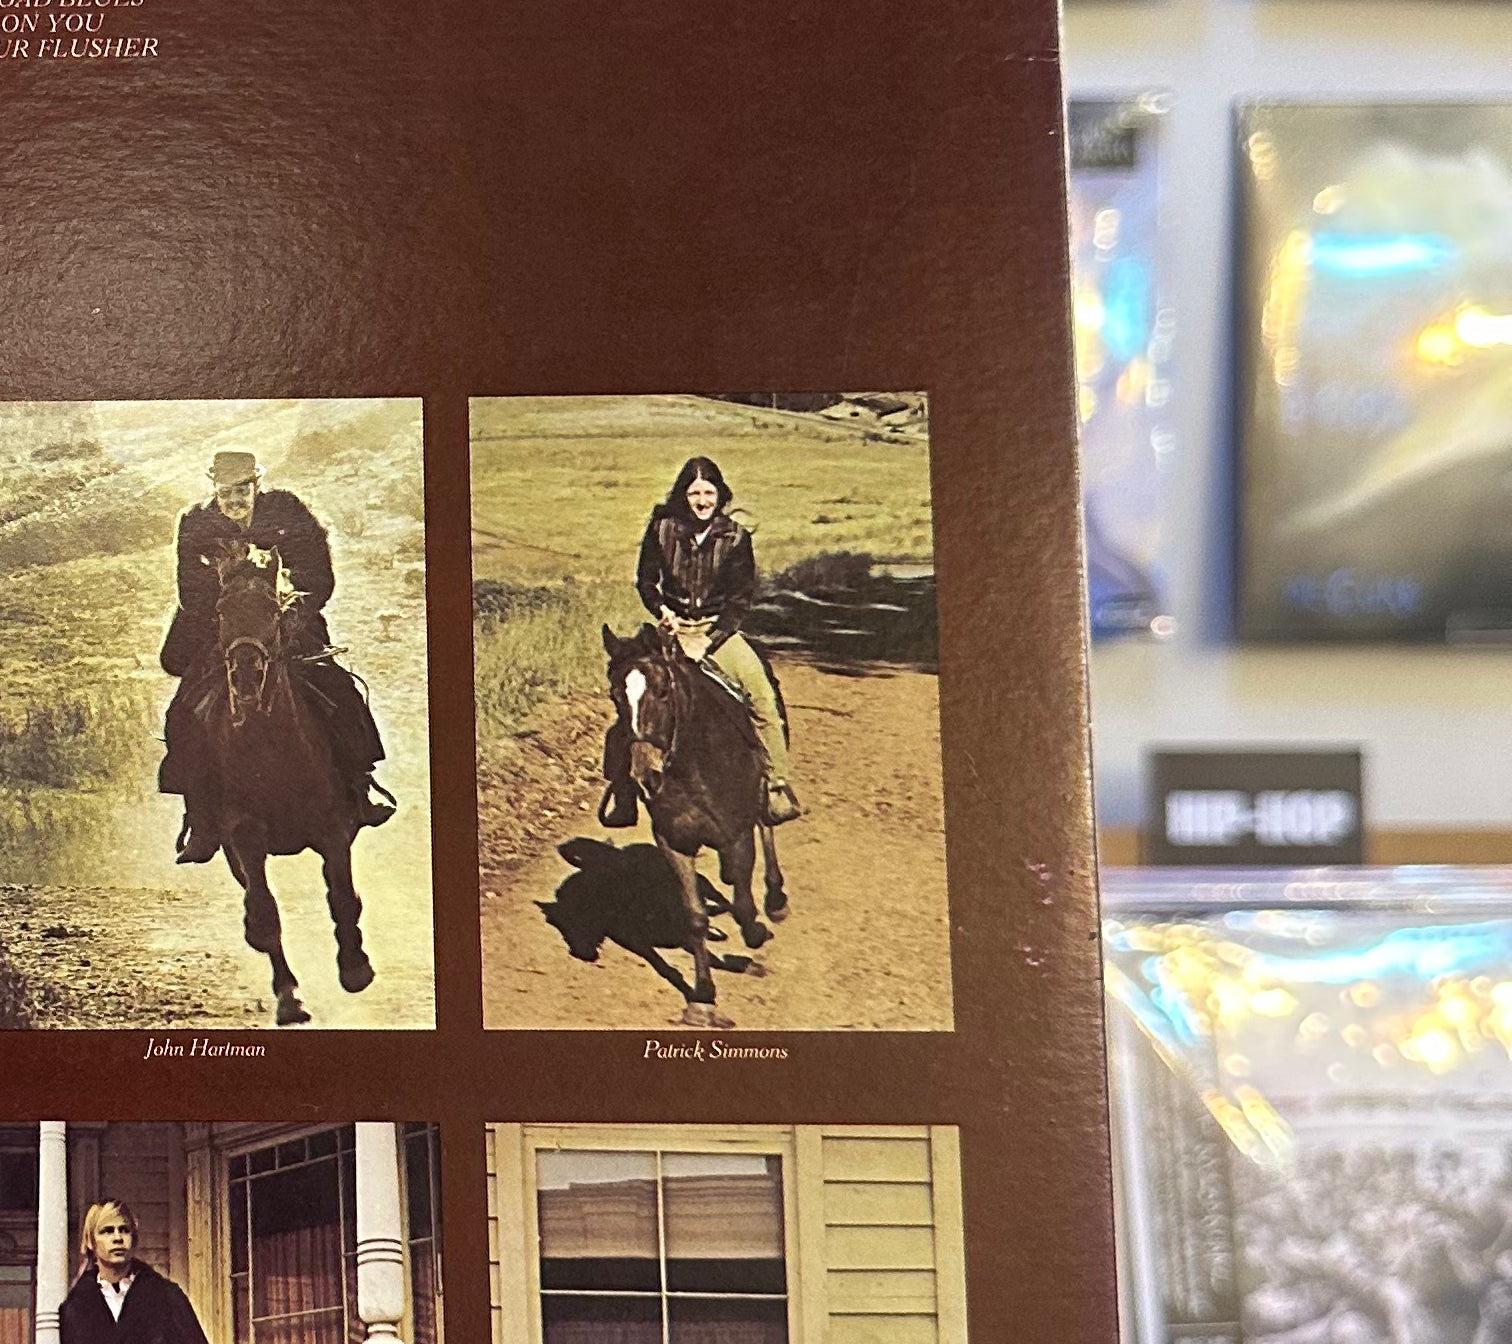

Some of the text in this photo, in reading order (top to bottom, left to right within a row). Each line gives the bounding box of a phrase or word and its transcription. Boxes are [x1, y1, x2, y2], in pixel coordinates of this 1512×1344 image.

[2, 12, 39, 32] ON
[49, 14, 104, 32] YOU
[38, 38, 158, 57] FLUSHER
[1166, 789, 1361, 846] HIP-HOP
[144, 1038, 265, 1059] John Hartman
[644, 1040, 788, 1061] Patrick Simmons
